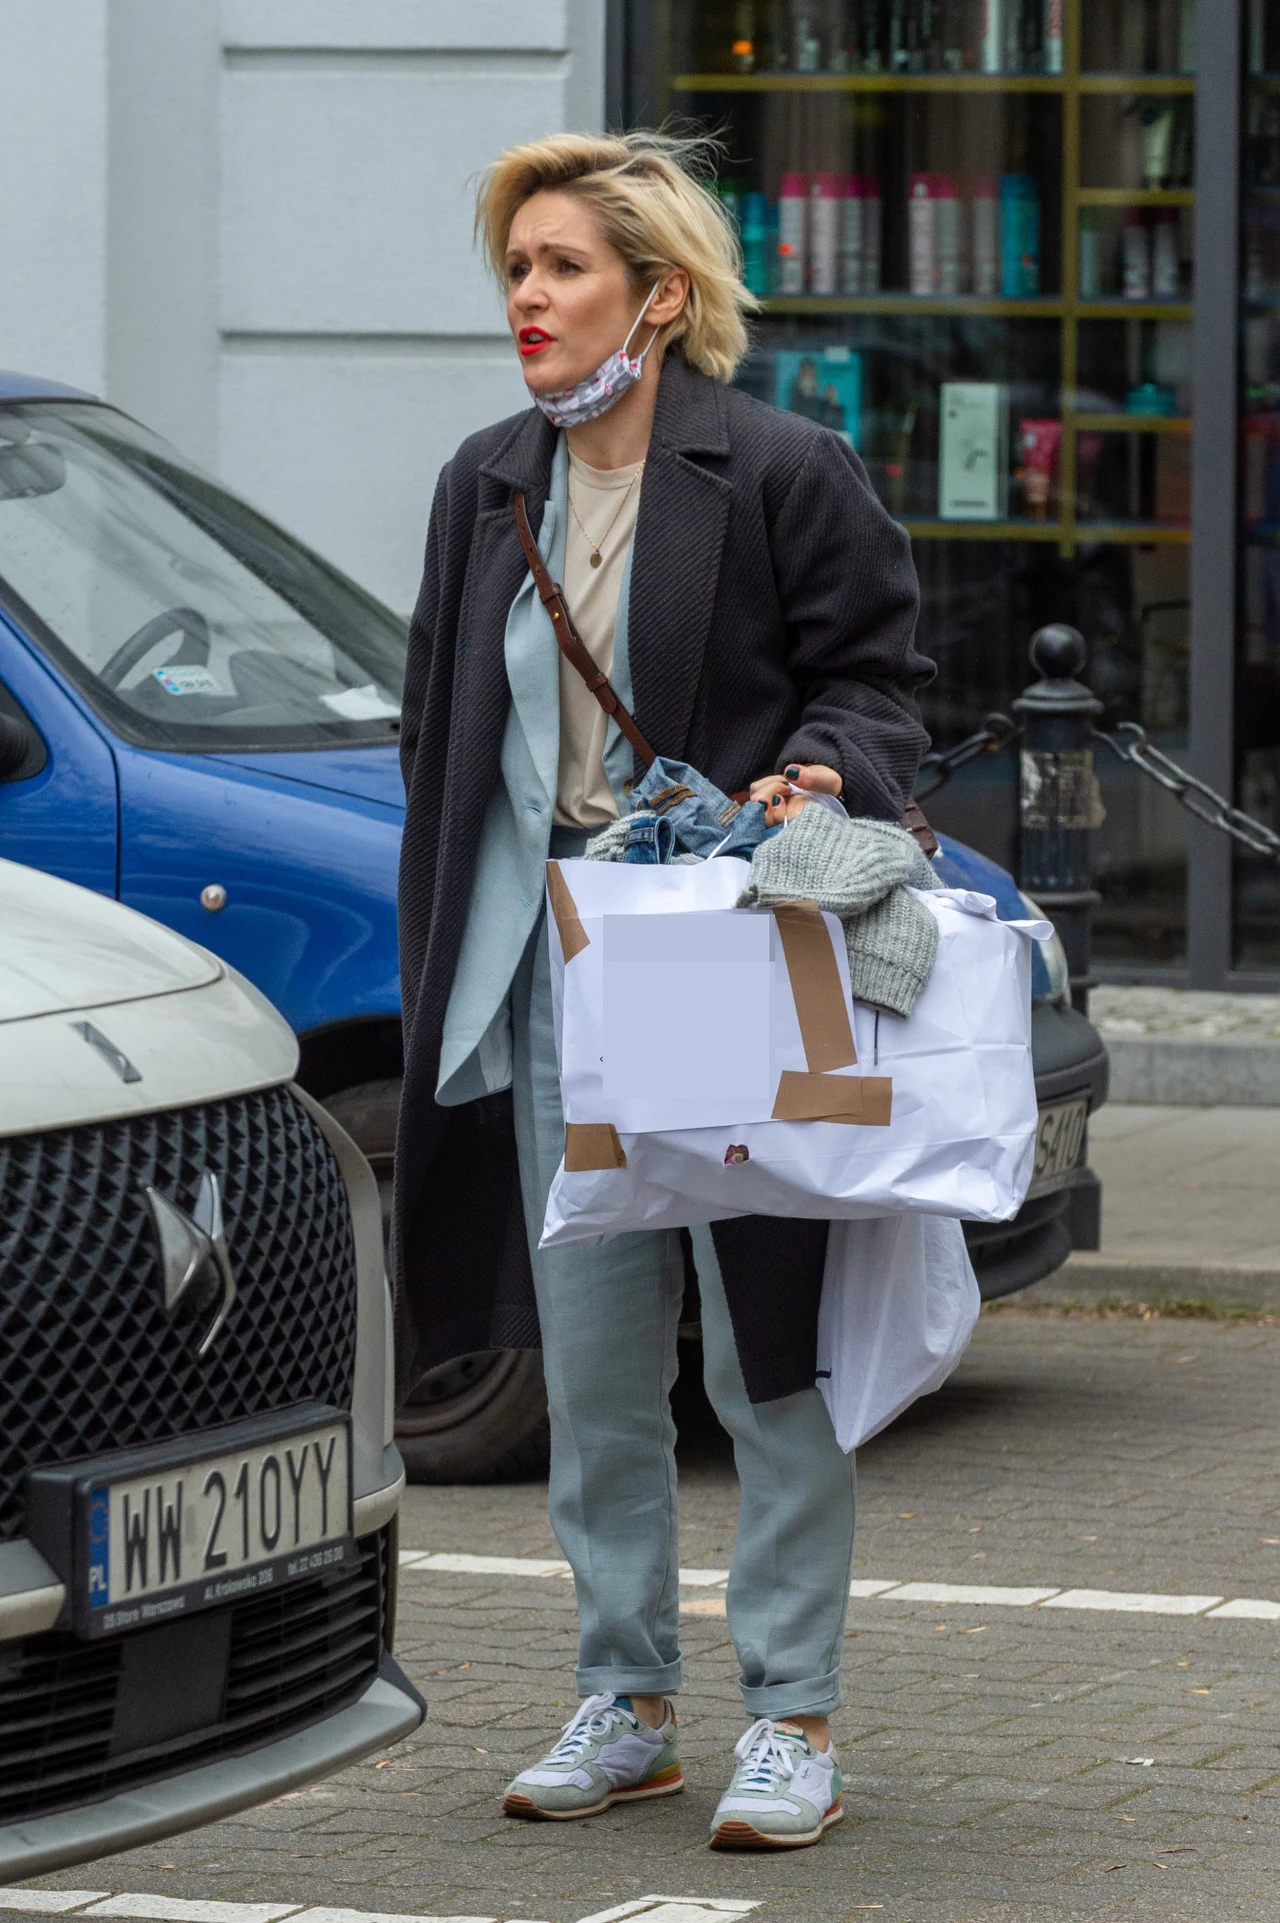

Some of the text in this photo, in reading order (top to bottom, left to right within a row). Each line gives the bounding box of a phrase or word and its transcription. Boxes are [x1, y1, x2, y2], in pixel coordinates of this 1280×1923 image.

[122, 1436, 336, 1593] WW 210YY
[89, 1564, 107, 1592] PL
